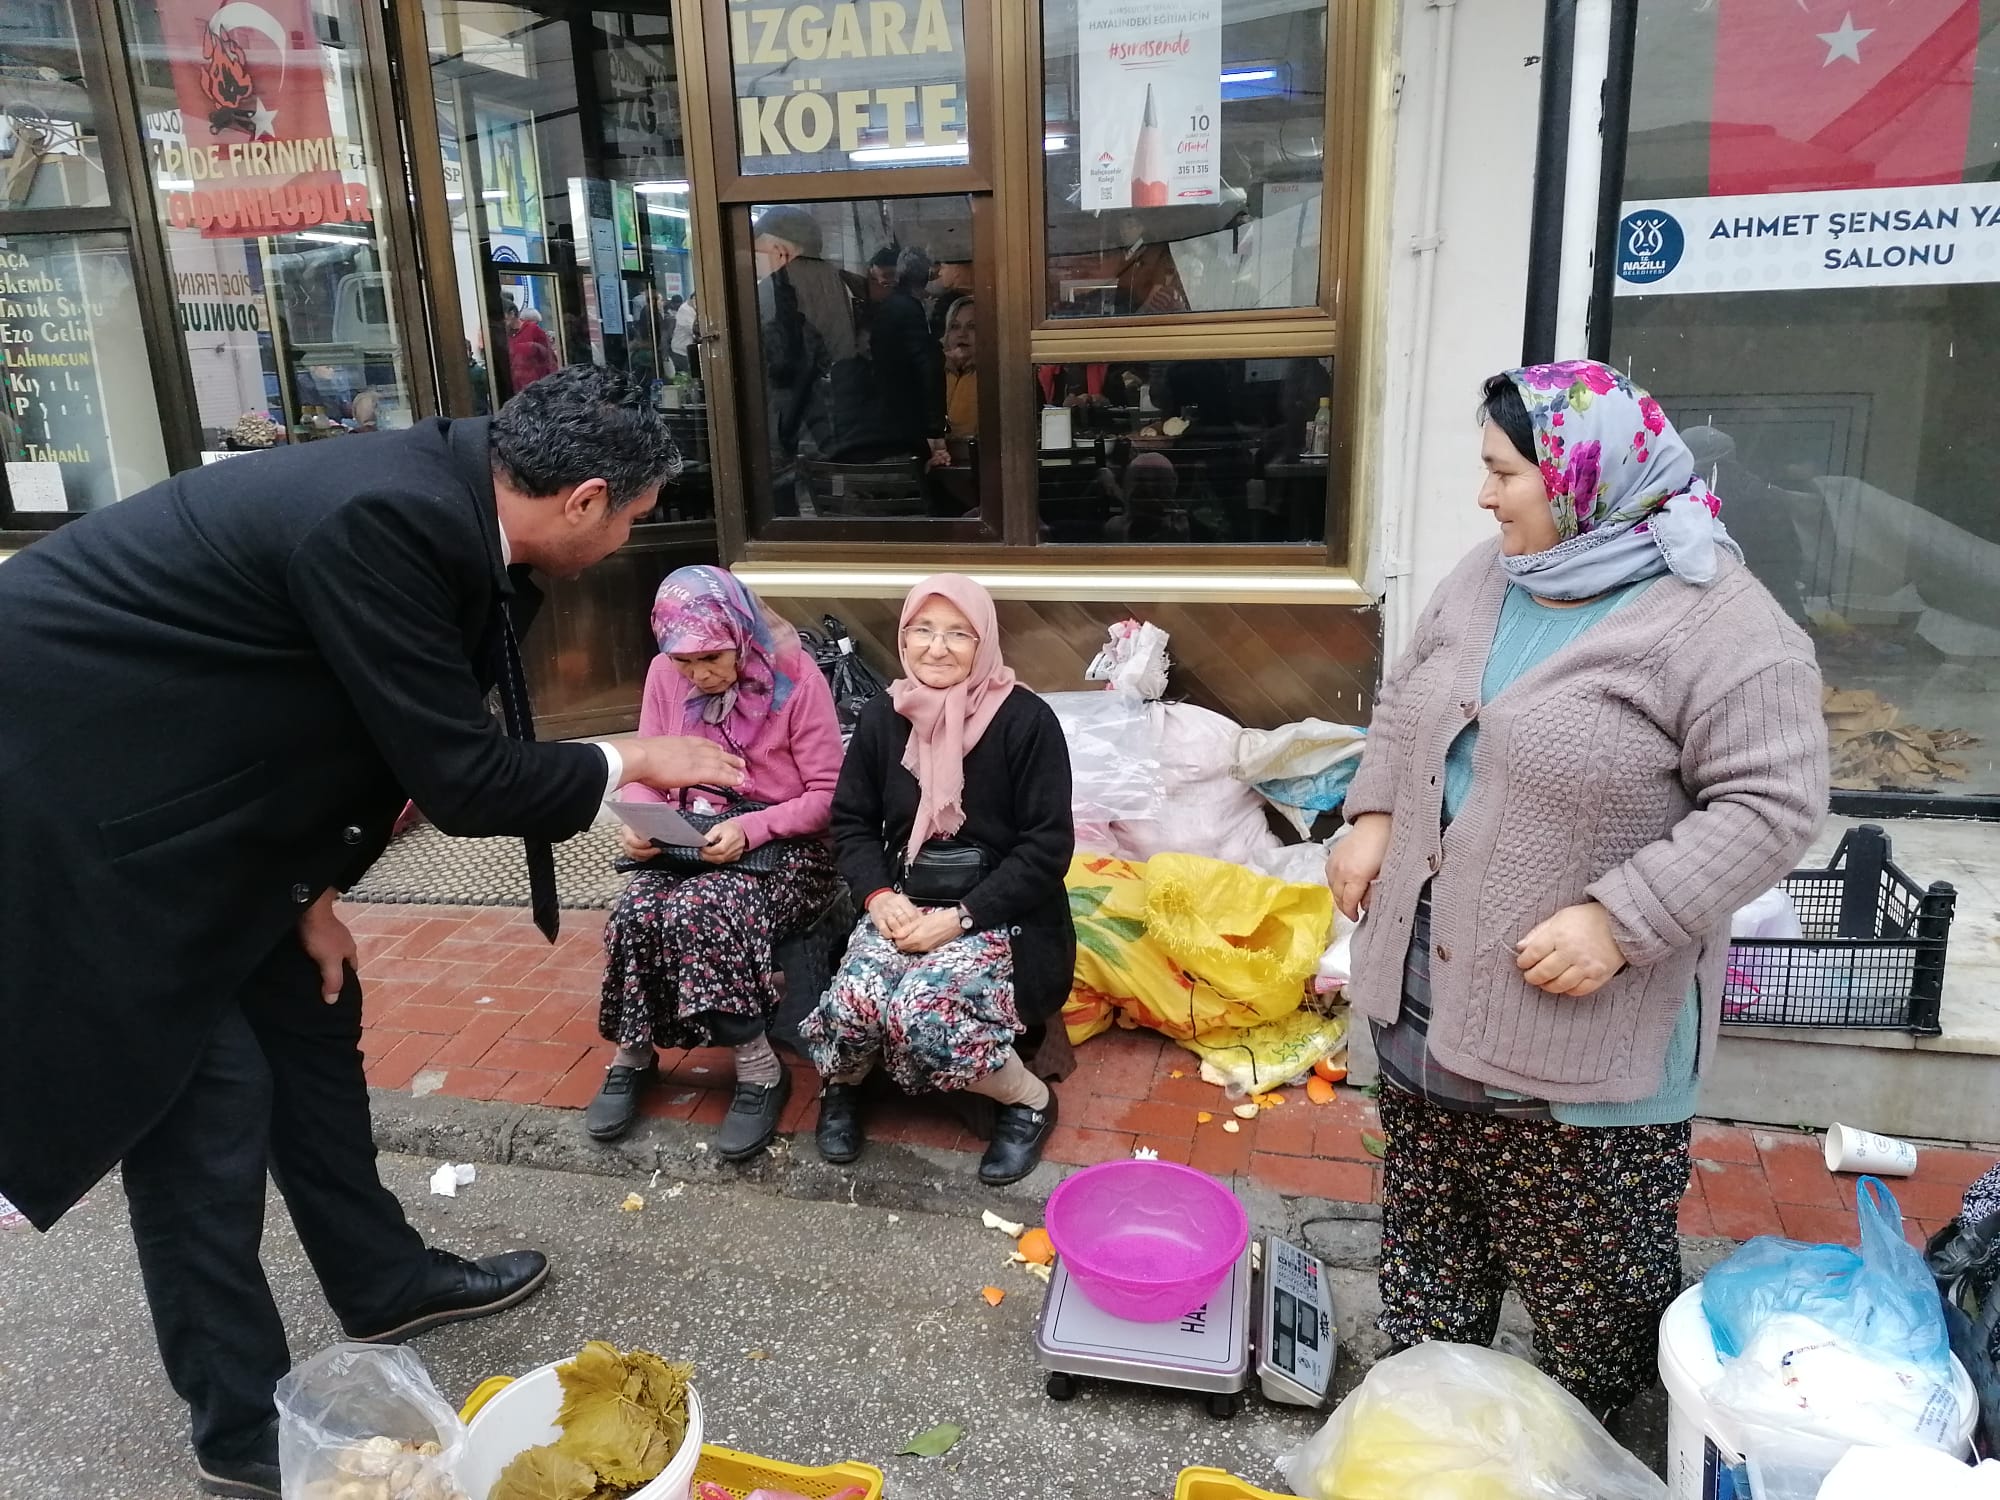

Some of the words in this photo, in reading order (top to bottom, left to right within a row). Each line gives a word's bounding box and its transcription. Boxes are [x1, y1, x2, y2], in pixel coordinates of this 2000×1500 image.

[740, 78, 959, 157] KÖFTE
[1190, 114, 1210, 132] 10
[1709, 214, 1820, 240] AHMET
[1828, 207, 1959, 239] ŞENSAN
[1823, 244, 1955, 270] SALONU
